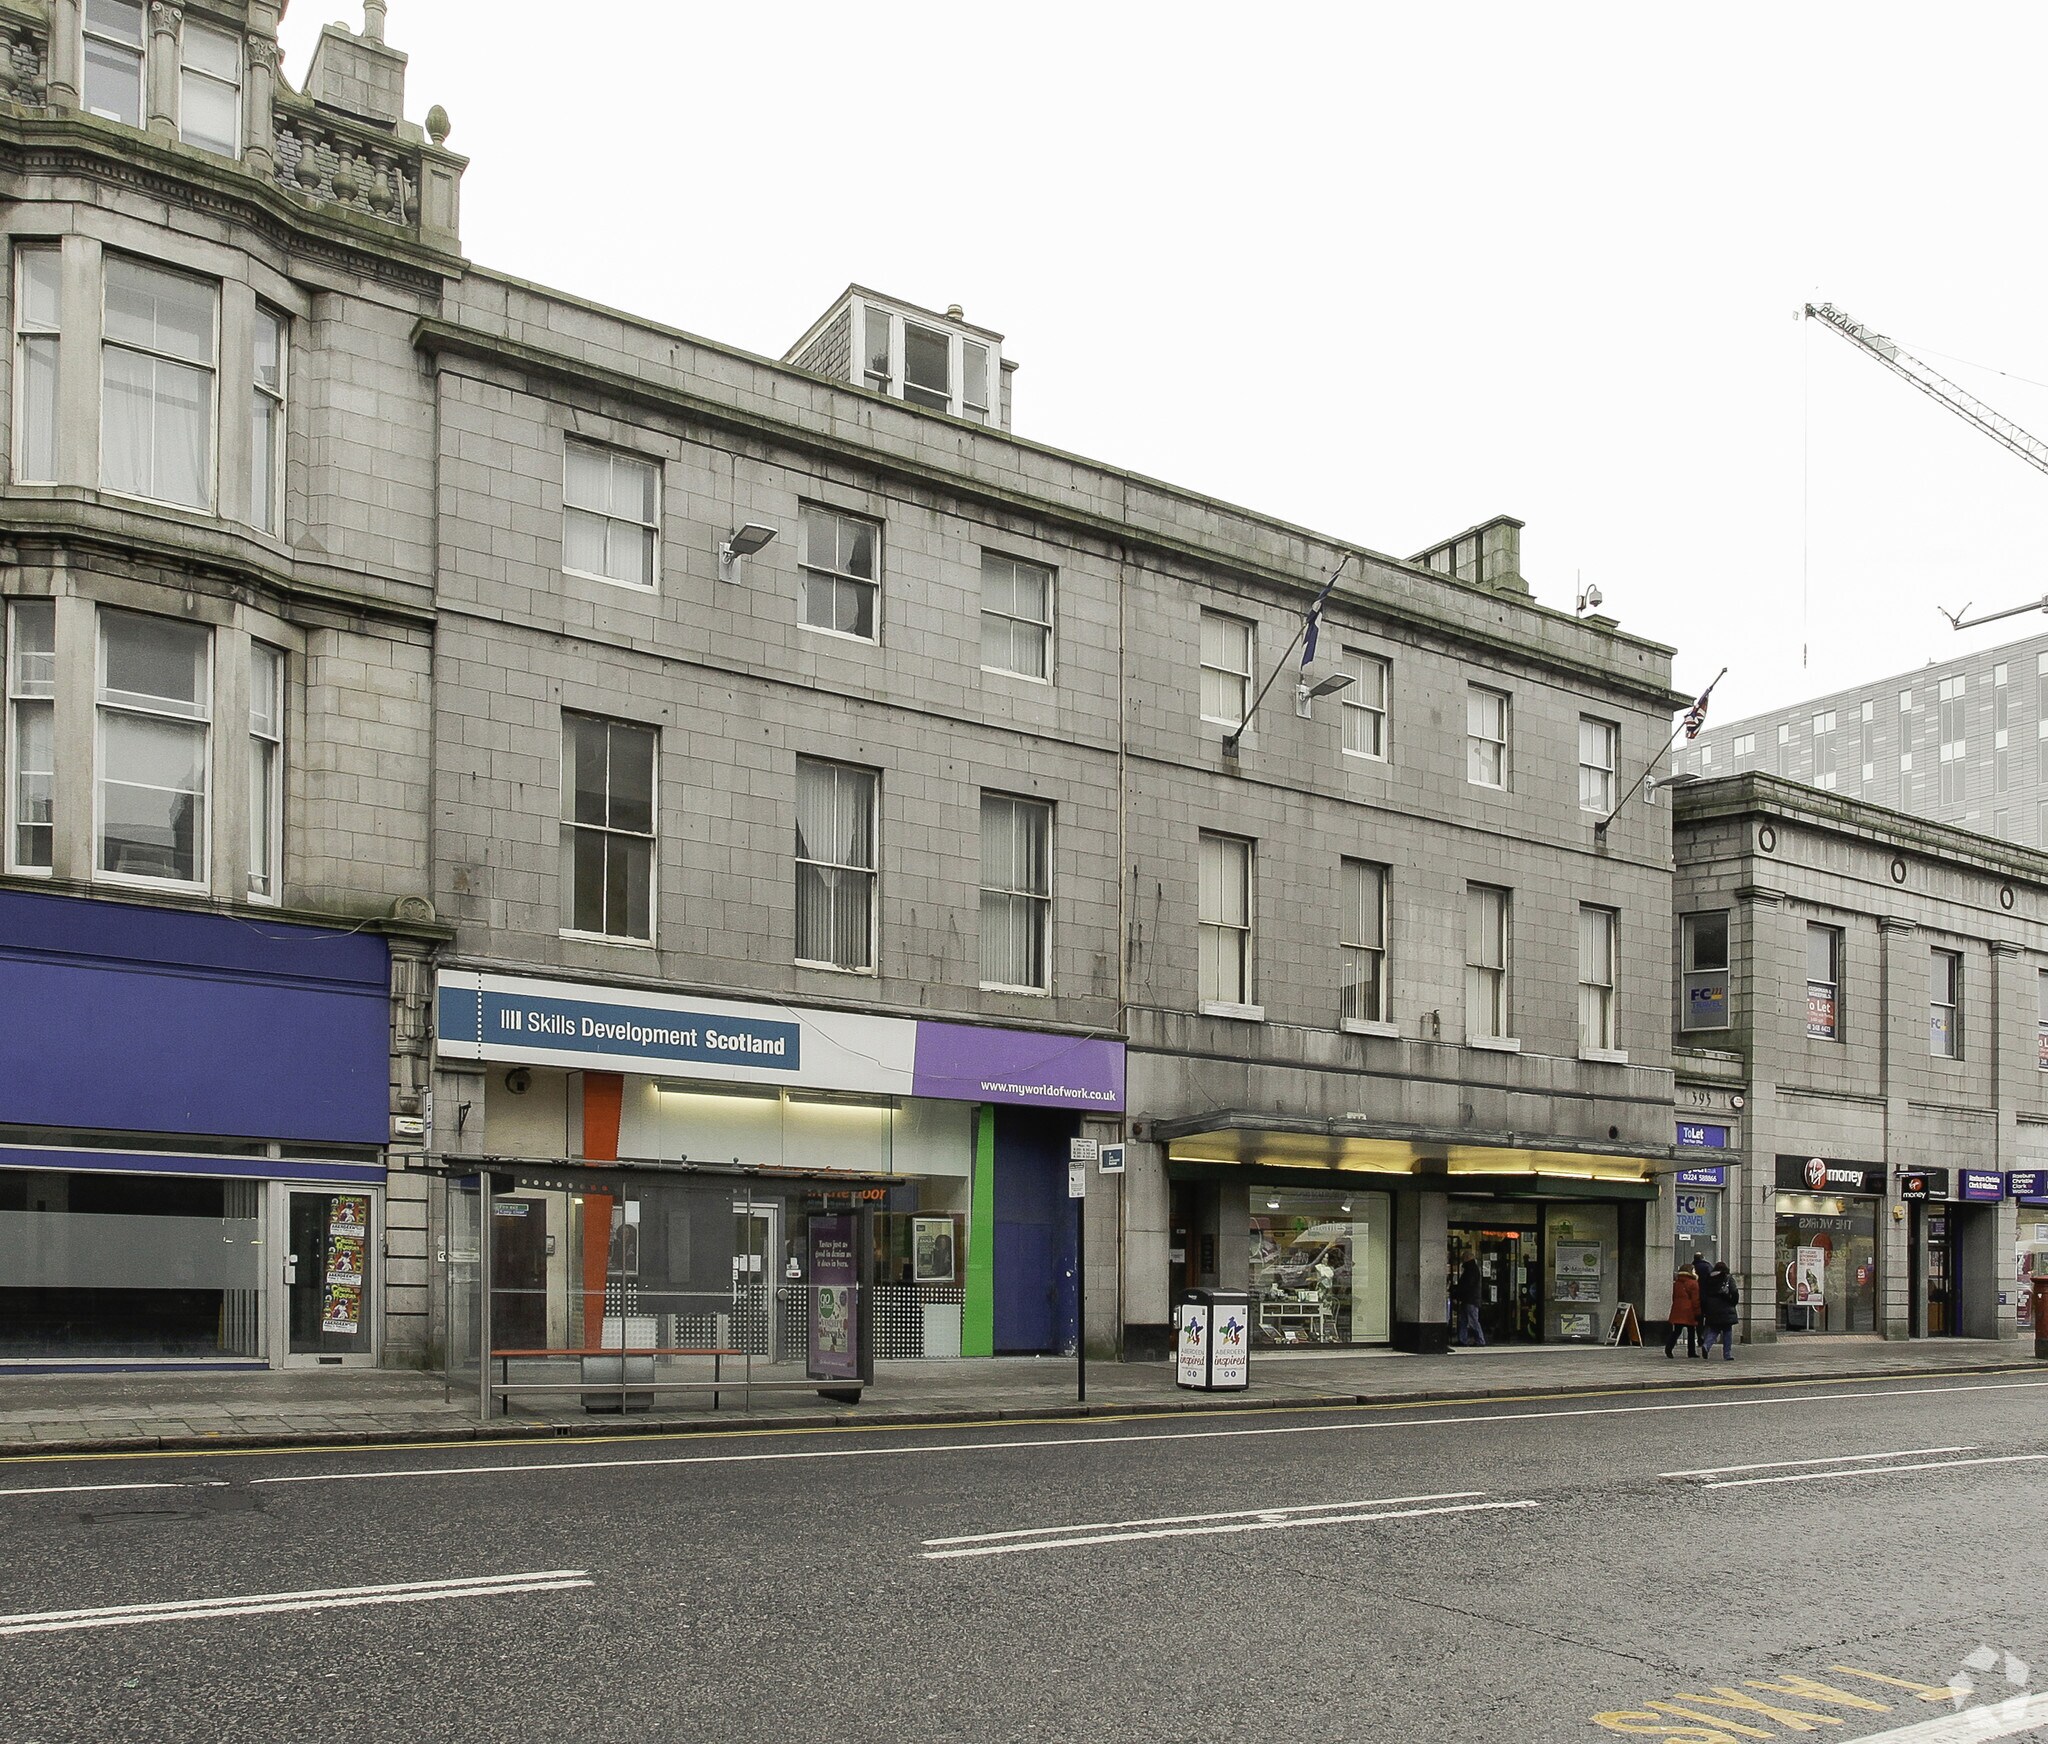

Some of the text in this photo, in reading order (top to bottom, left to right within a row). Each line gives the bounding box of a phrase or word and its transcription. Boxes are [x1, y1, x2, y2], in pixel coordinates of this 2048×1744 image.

[1819, 305, 1859, 335] POTAIN
[1816, 1000, 1831, 1013] Let
[527, 1011, 785, 1056] Skills Development Scotland
[980, 1081, 1116, 1101] www.myworldofwork.co.uk
[1826, 1168, 1864, 1187] money
[1903, 1191, 1927, 1199] money
[1676, 1214, 1706, 1226] TRAVEL
[1181, 1348, 1204, 1356] ABERDEEN
[1180, 1354, 1205, 1367] inspired
[1215, 1355, 1246, 1367] inspired
